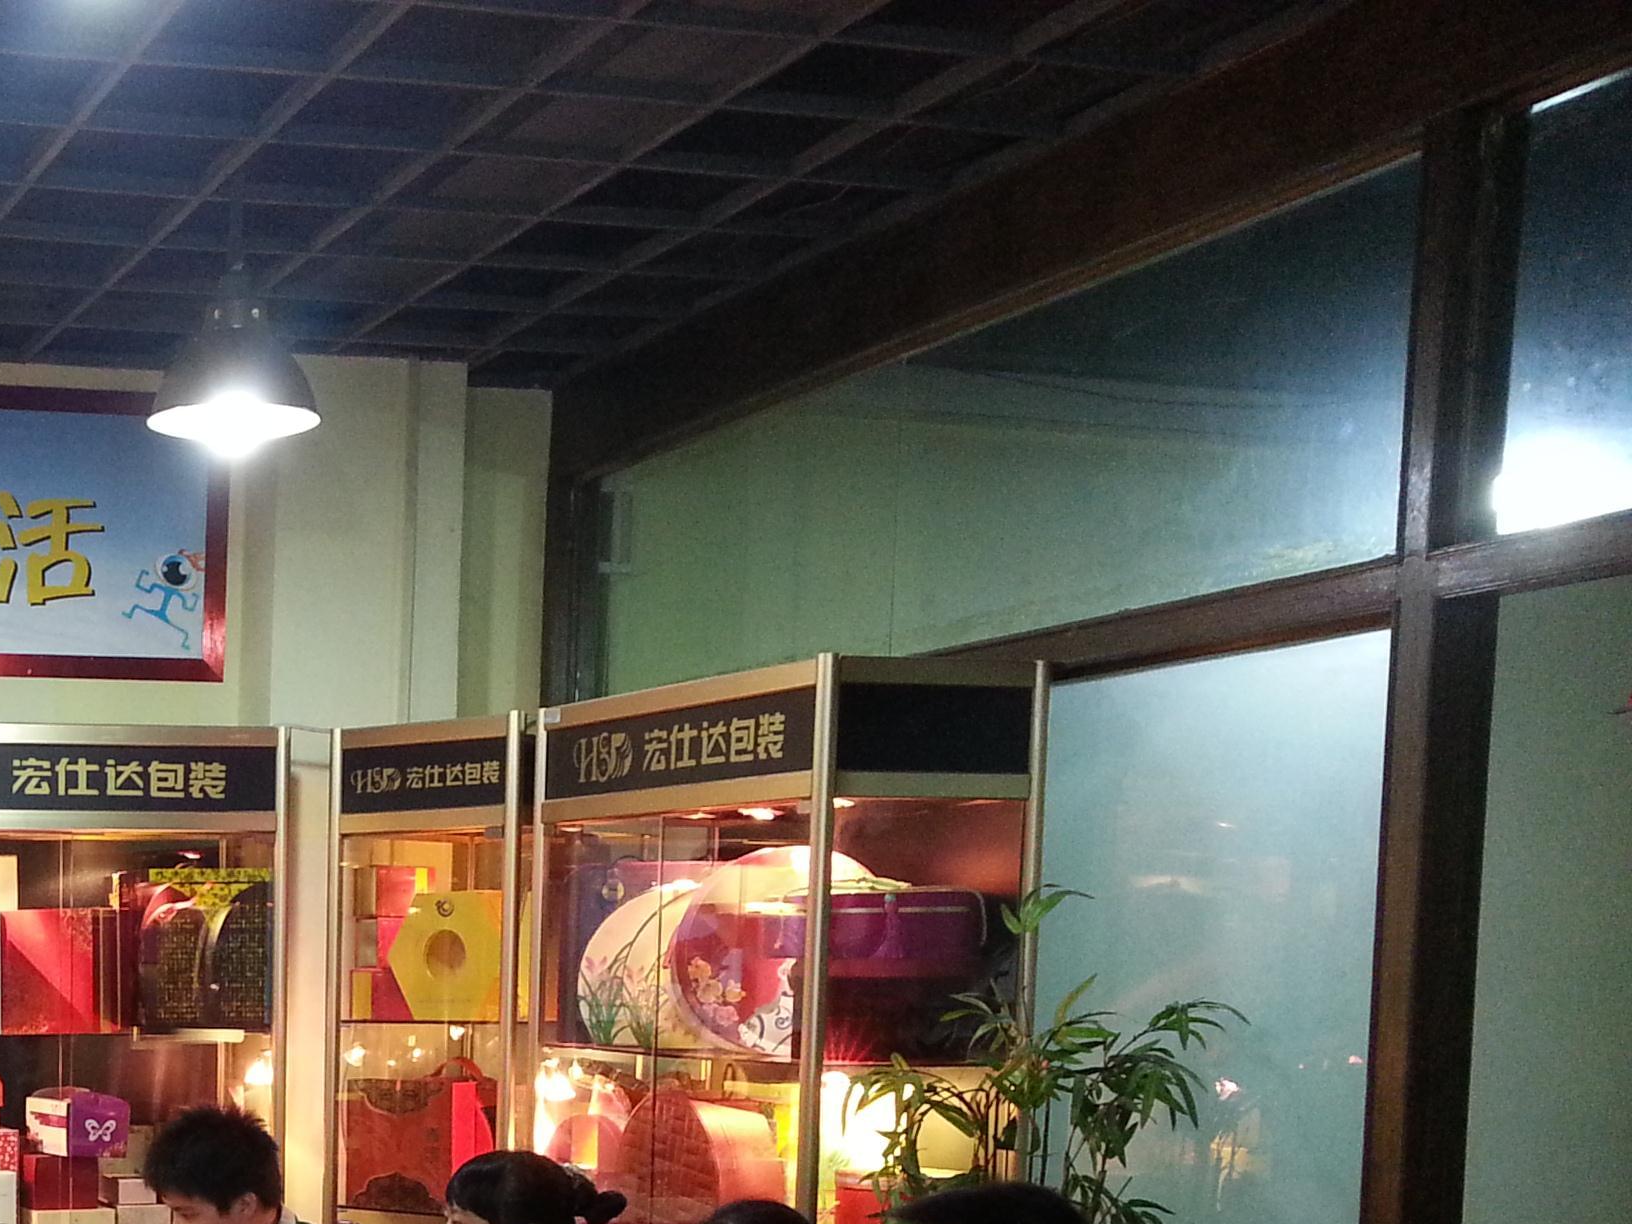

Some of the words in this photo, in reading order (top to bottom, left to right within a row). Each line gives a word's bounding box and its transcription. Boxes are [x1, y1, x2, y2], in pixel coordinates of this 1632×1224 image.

[642, 712, 786, 772] 宏仕达包装
[11, 758, 227, 799] 宏仕达包装
[406, 760, 501, 789] 宏仕达包装
